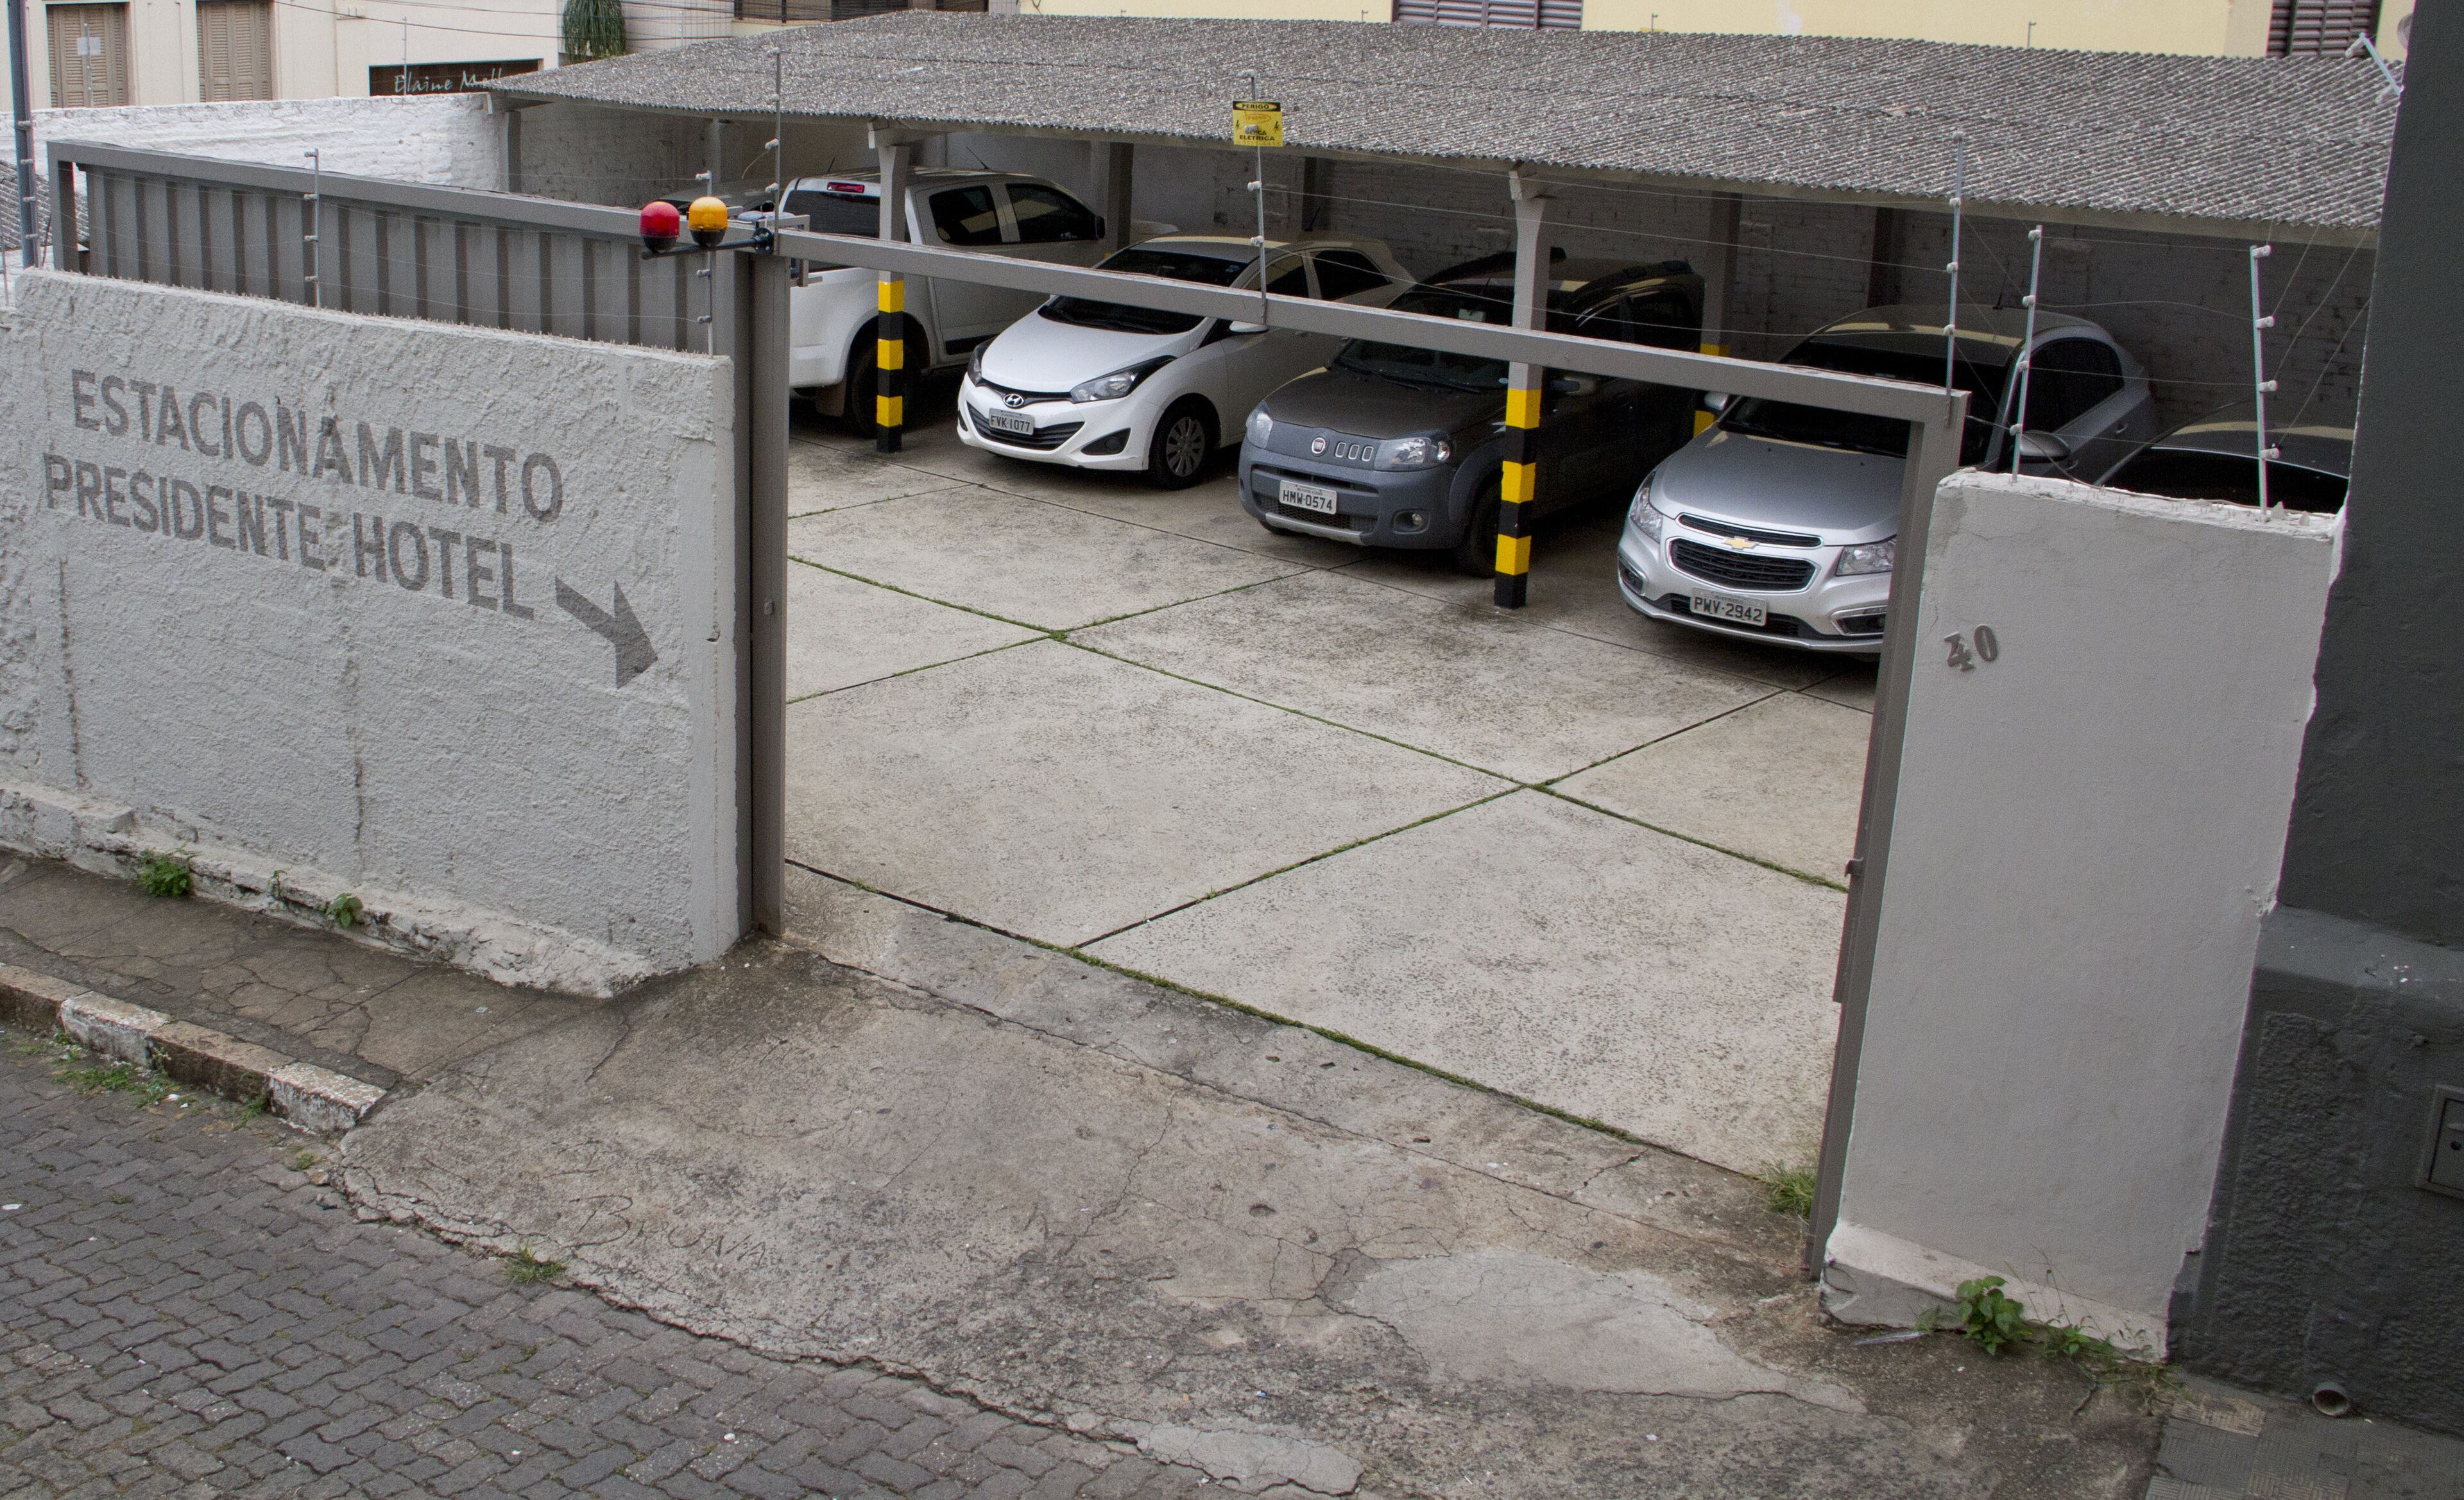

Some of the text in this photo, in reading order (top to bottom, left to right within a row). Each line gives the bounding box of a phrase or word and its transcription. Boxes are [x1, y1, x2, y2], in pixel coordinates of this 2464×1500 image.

[394, 71, 453, 93] Elaine
[71, 368, 563, 523] ESTACIONAMENTO
[43, 452, 535, 620] PRESIDENTE HOTEL
[1944, 624, 1999, 672] 40
